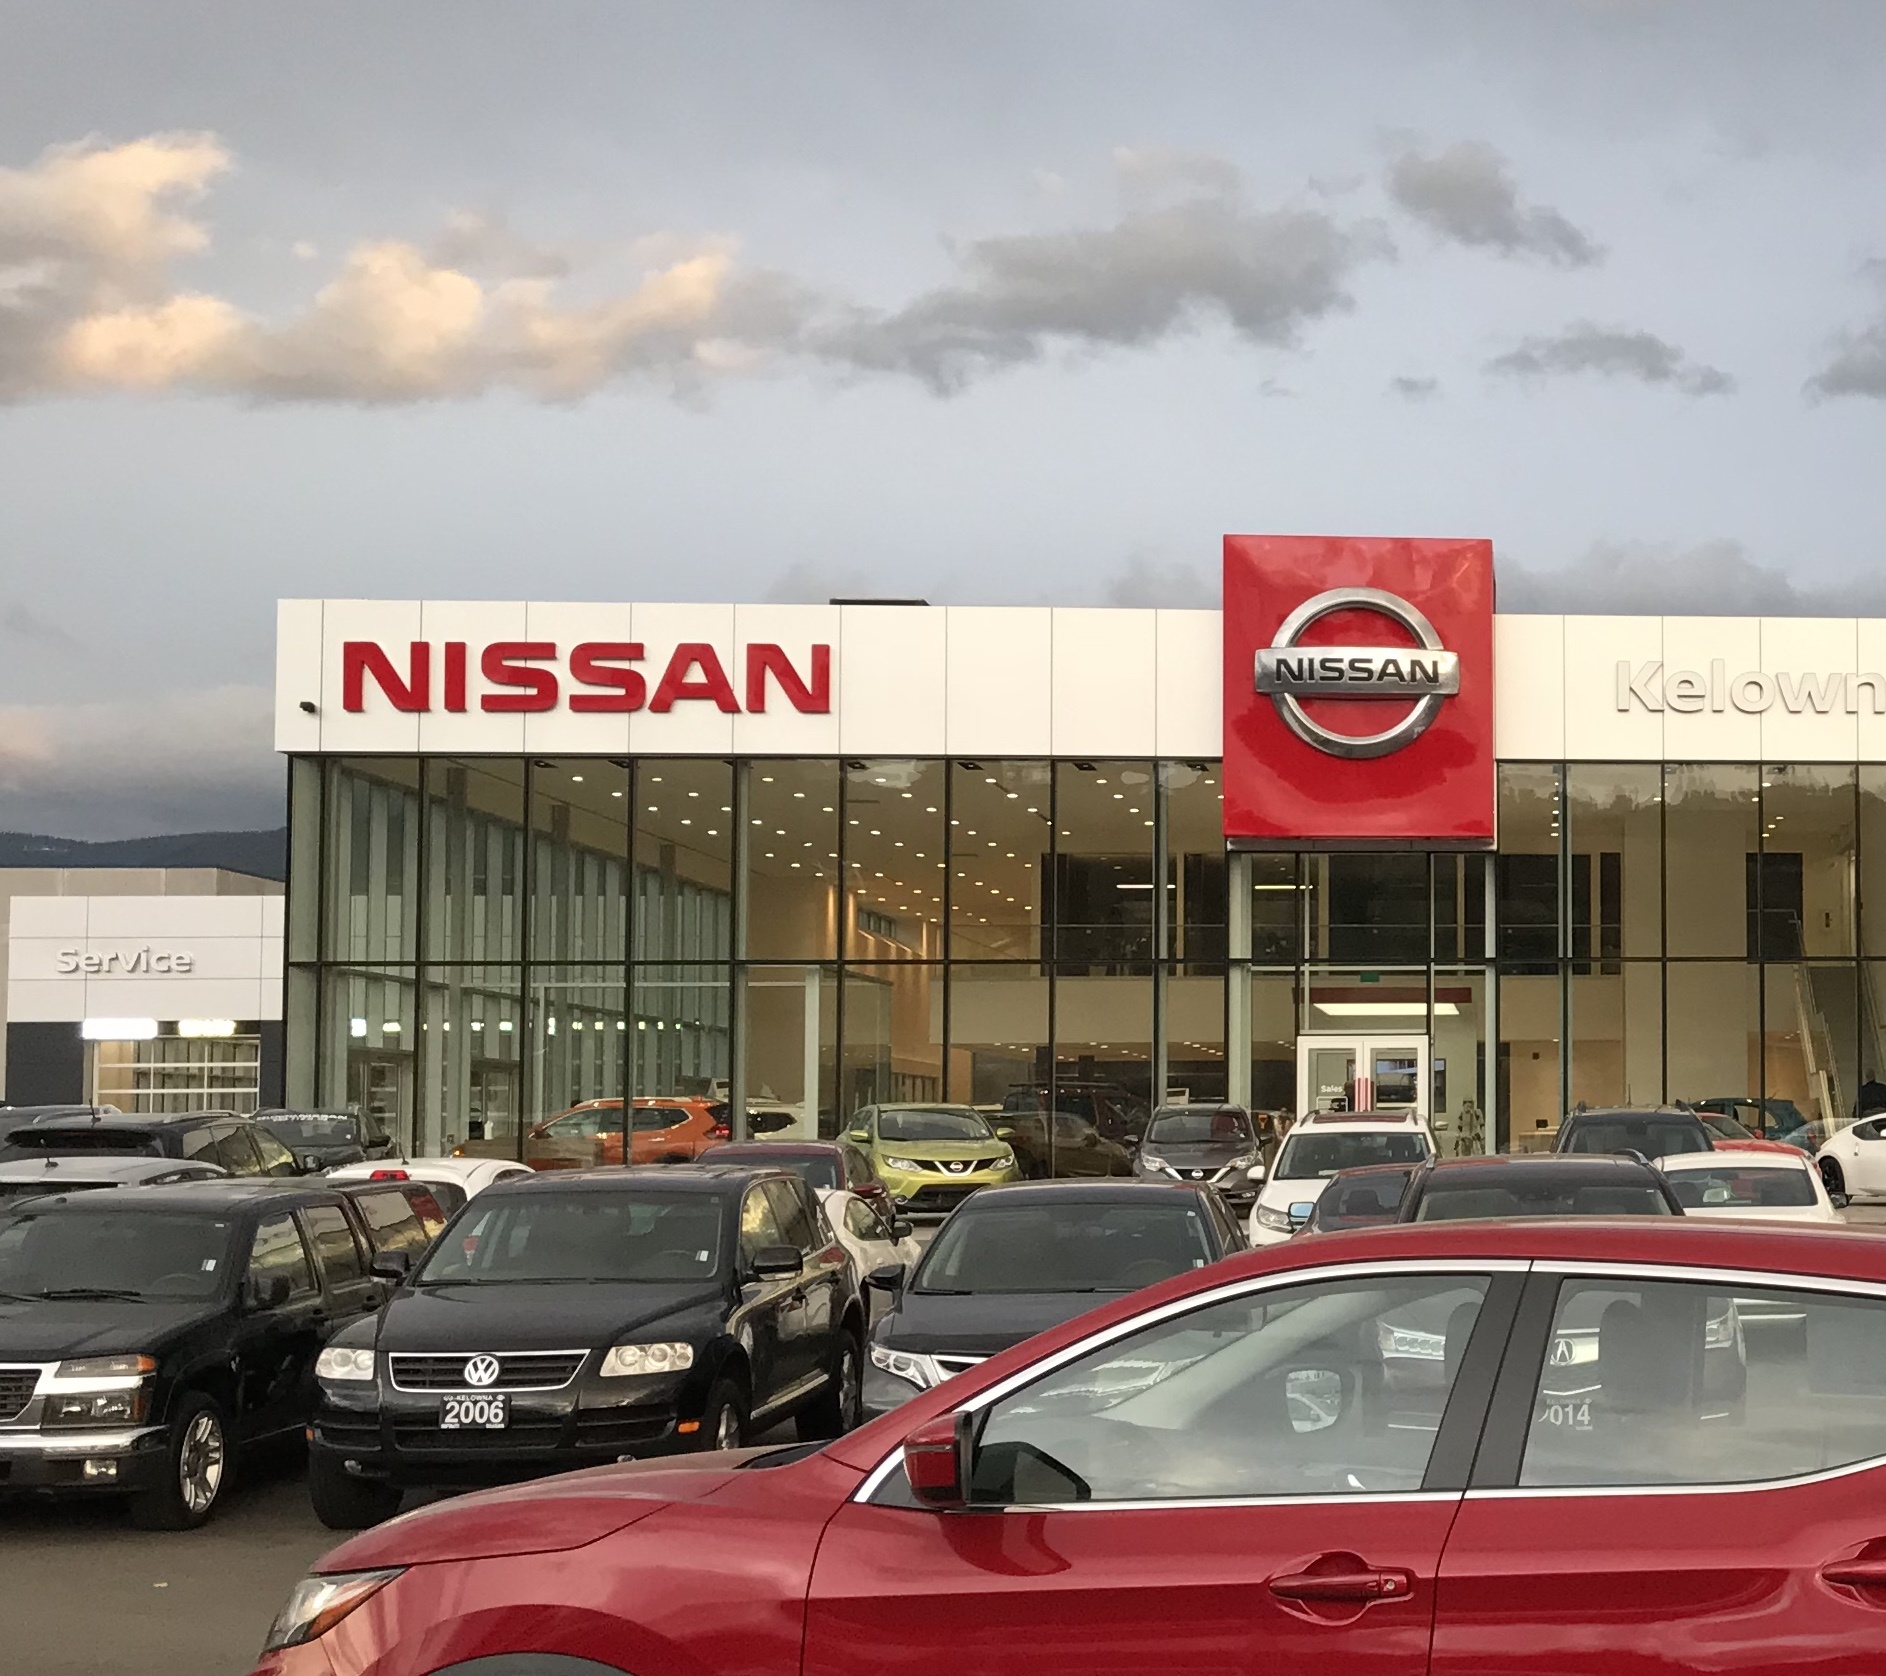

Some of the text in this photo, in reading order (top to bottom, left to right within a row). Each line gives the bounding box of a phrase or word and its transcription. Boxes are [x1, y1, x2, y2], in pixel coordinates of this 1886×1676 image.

[342, 641, 831, 713] NISSAN
[1275, 657, 1440, 685] NISSAN
[55, 944, 195, 974] Service
[1320, 1084, 1343, 1093] Sales
[444, 1401, 504, 1424] 2006
